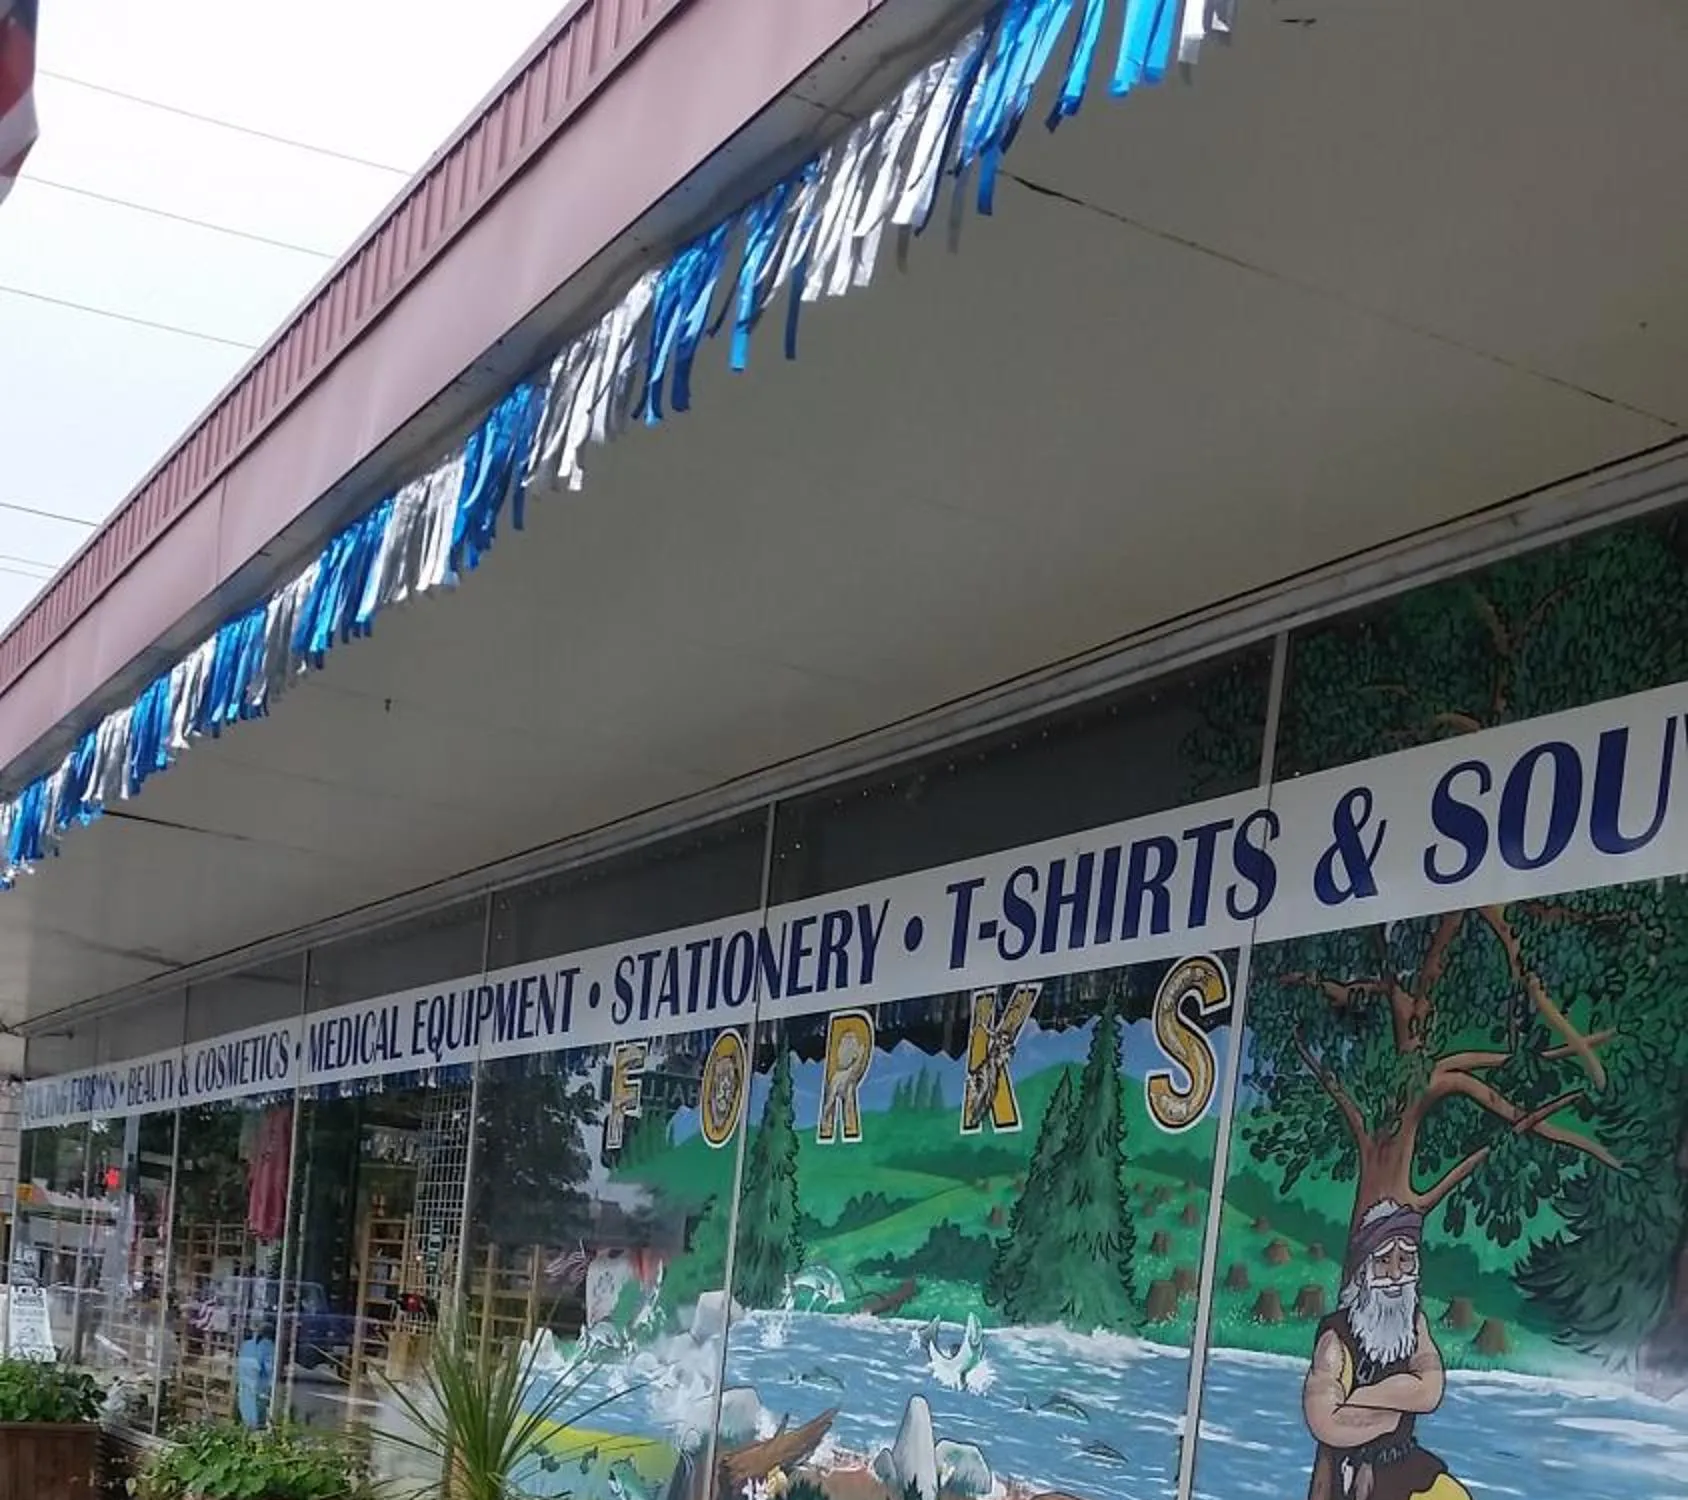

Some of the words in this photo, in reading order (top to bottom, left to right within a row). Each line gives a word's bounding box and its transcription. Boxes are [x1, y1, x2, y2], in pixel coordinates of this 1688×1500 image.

[127, 1059, 175, 1106] BEAUTY
[178, 1055, 189, 1096] &
[194, 1029, 290, 1093] COSMETICS
[308, 1005, 402, 1072] MEDICAL
[411, 967, 580, 1061] EQUIPMENT
[611, 899, 890, 1025] STATIONERY
[946, 808, 1280, 969] T-SHIRTS
[1313, 786, 1387, 905] &
[1422, 713, 1688, 884] SOU
